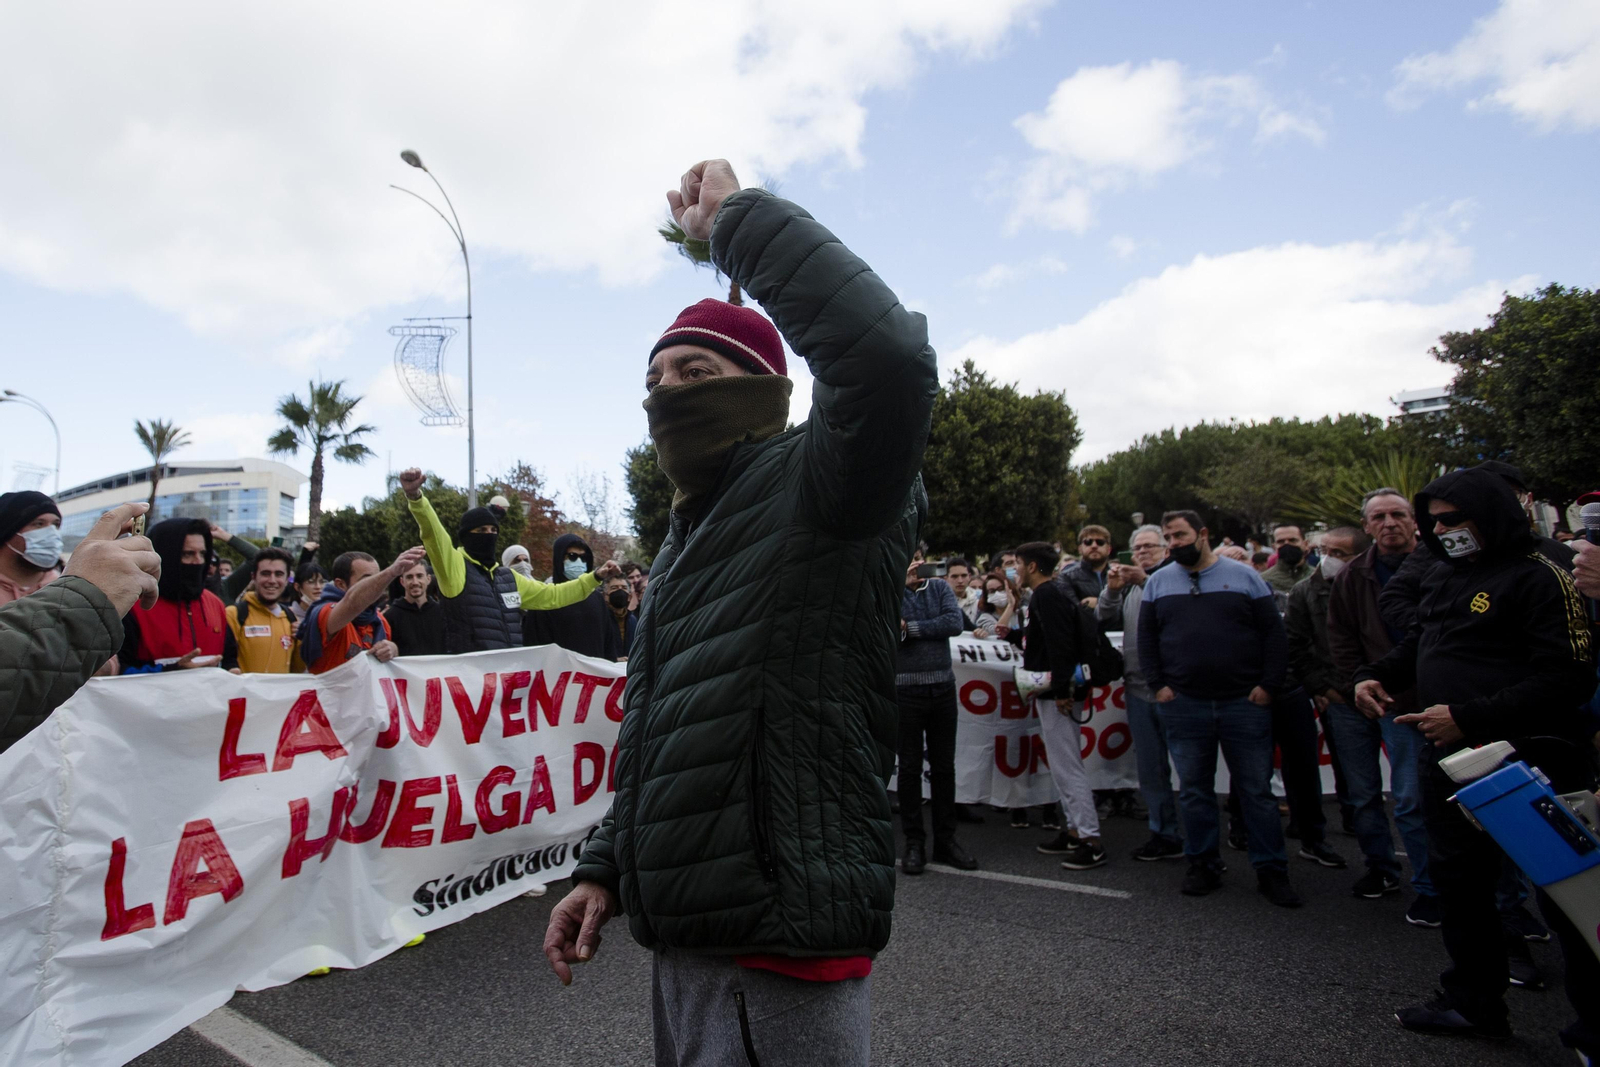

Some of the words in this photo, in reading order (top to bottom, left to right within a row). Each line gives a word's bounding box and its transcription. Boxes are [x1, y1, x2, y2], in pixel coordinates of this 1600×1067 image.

[957, 645, 986, 663] NI
[219, 689, 349, 782] LA
[100, 817, 245, 942] LA
[281, 754, 557, 880] HUELGA
